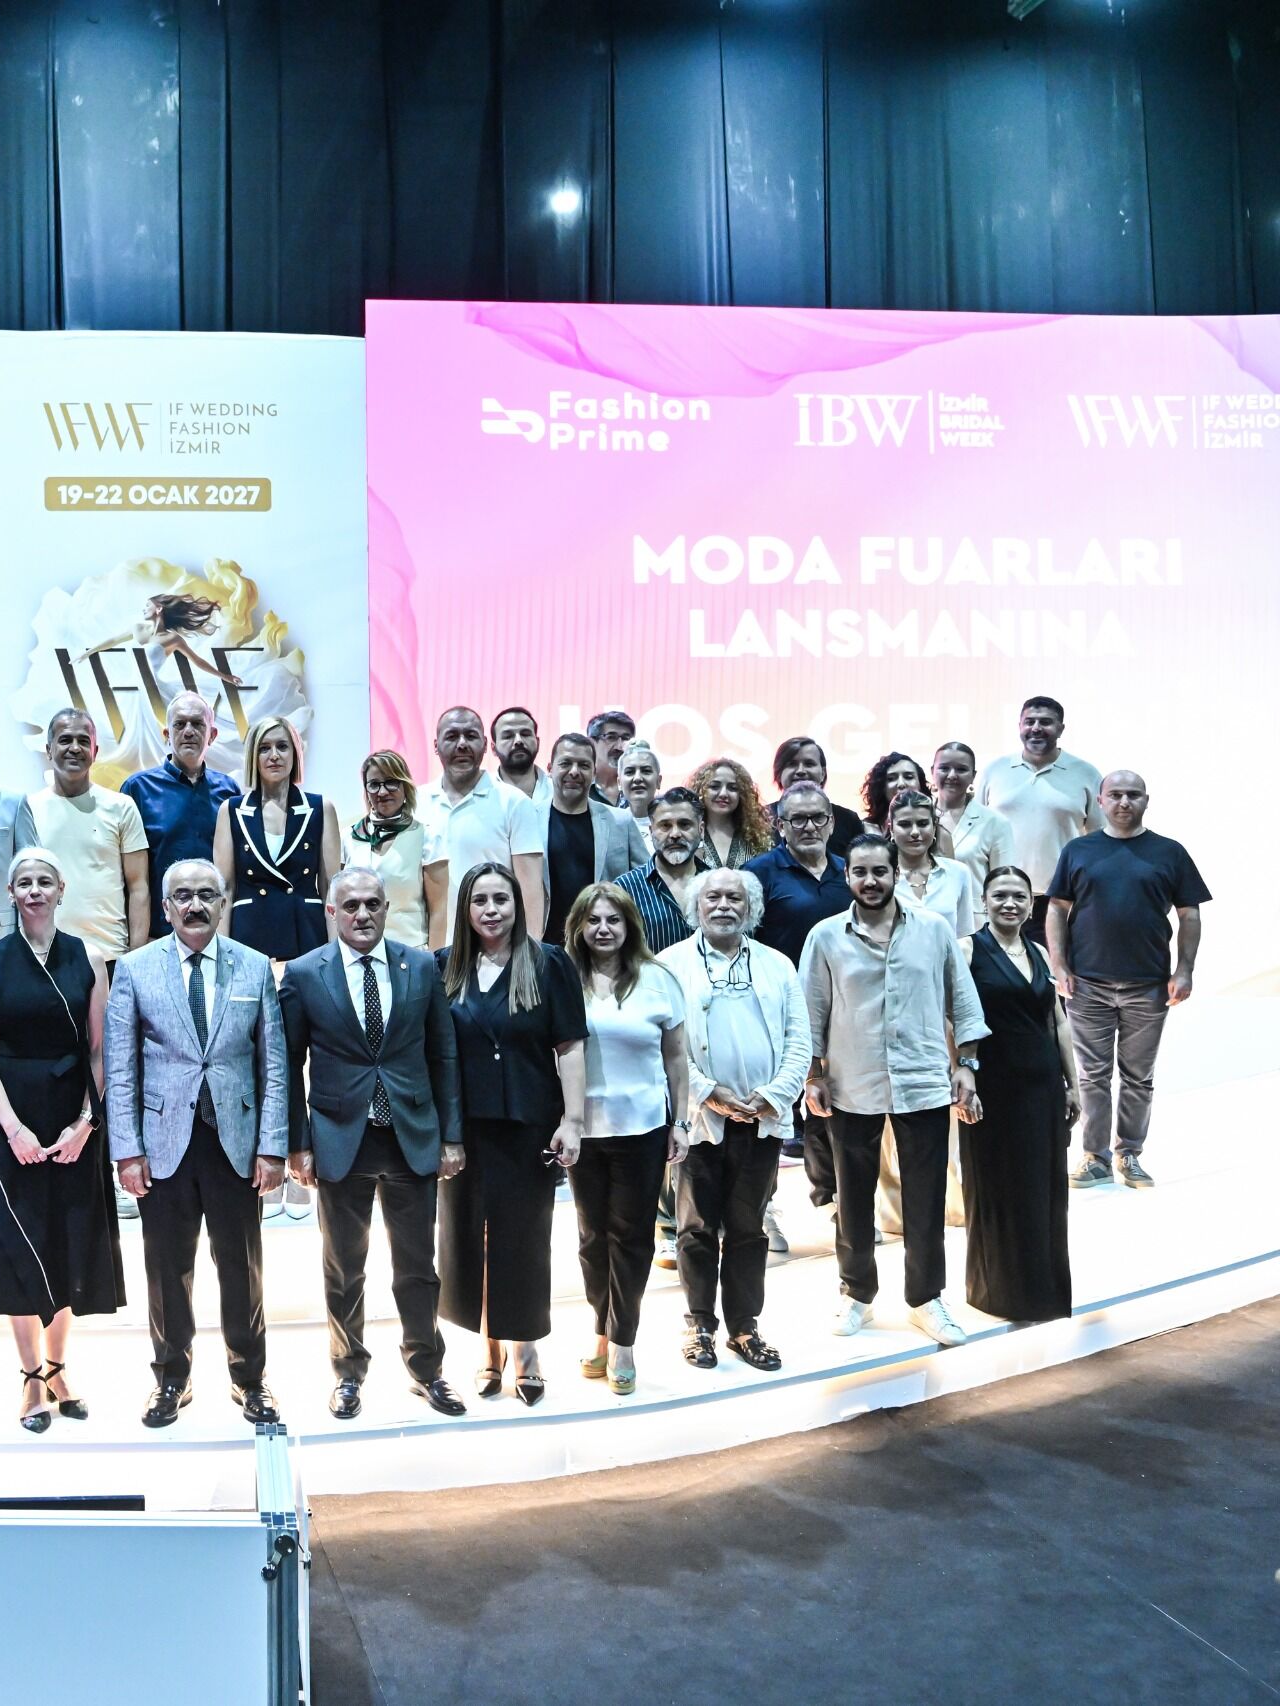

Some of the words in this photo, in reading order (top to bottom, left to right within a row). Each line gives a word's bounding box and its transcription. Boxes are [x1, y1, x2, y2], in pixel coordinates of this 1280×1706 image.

[169, 402, 184, 416] IF
[189, 402, 278, 417] WEDDING
[548, 390, 712, 421] Fashion
[1202, 394, 1221, 411] IF
[169, 421, 251, 436] FASHION
[938, 414, 1005, 430] BRIDAL
[549, 422, 671, 452] Prime
[939, 431, 995, 447] WEEK
[57, 484, 123, 505] 19-22
[128, 484, 200, 505] OCAK
[204, 485, 261, 506] 2027
[632, 534, 842, 585] MODA
[859, 536, 1184, 586] FUARLARI
[688, 608, 1137, 658] LANSMANINA
